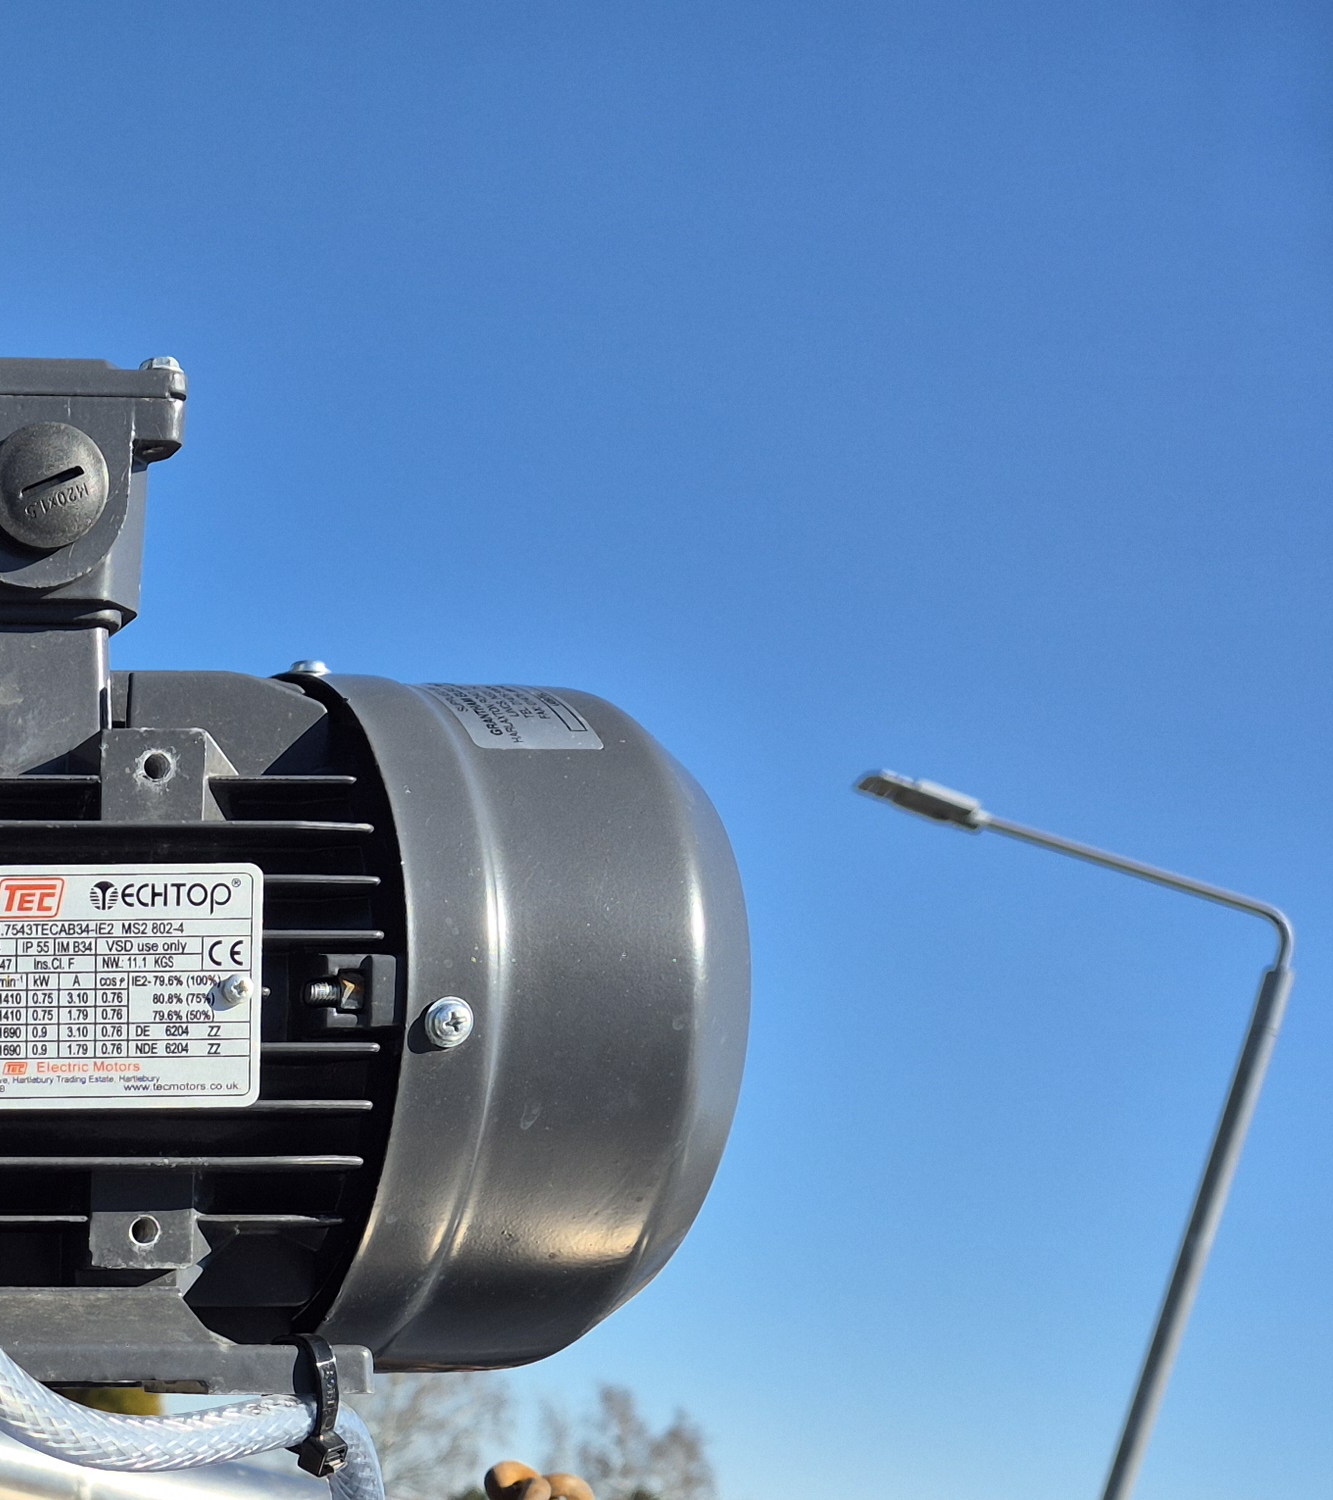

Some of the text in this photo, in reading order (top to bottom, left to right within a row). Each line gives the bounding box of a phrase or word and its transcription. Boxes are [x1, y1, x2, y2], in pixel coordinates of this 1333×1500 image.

[24, 482, 89, 519] M20x1.5
[4, 884, 57, 912] TEC
[121, 922, 148, 935] MS2
[151, 922, 184, 934] 802-4
[22, 940, 50, 954] IP 55
[57, 940, 93, 953] IM B34
[106, 939, 187, 954] VSD use only
[68, 957, 75, 969] F
[127, 956, 147, 969] 11.1
[154, 956, 174, 968] KGS
[33, 975, 50, 987] kW
[72, 975, 81, 987] A
[99, 977, 118, 987] cos
[153, 975, 184, 987] 79.6%
[186, 974, 221, 988] (100%)
[32, 992, 54, 1005] 0.75
[67, 992, 89, 1004] 3.10
[101, 992, 123, 1004] 0.76
[153, 993, 183, 1005] 80.8%
[32, 1009, 54, 1022] 0.75
[67, 1009, 89, 1021] 1.79
[101, 1009, 123, 1021] 0.76
[153, 1009, 215, 1022] 79.6% (50%)
[32, 1026, 48, 1039] 0.9
[67, 1026, 89, 1038] 3.10
[101, 1026, 123, 1038] 0.76
[135, 1025, 221, 1037] DE 6204 ZZ
[32, 1044, 48, 1056] 0.9
[67, 1043, 89, 1056] 1.79
[101, 1043, 123, 1056] 0.76
[135, 1043, 221, 1055] NDE 6204 ZZ
[36, 1061, 89, 1073] Electric
[93, 1061, 141, 1072] Motors
[57, 1075, 87, 1085] Trading
